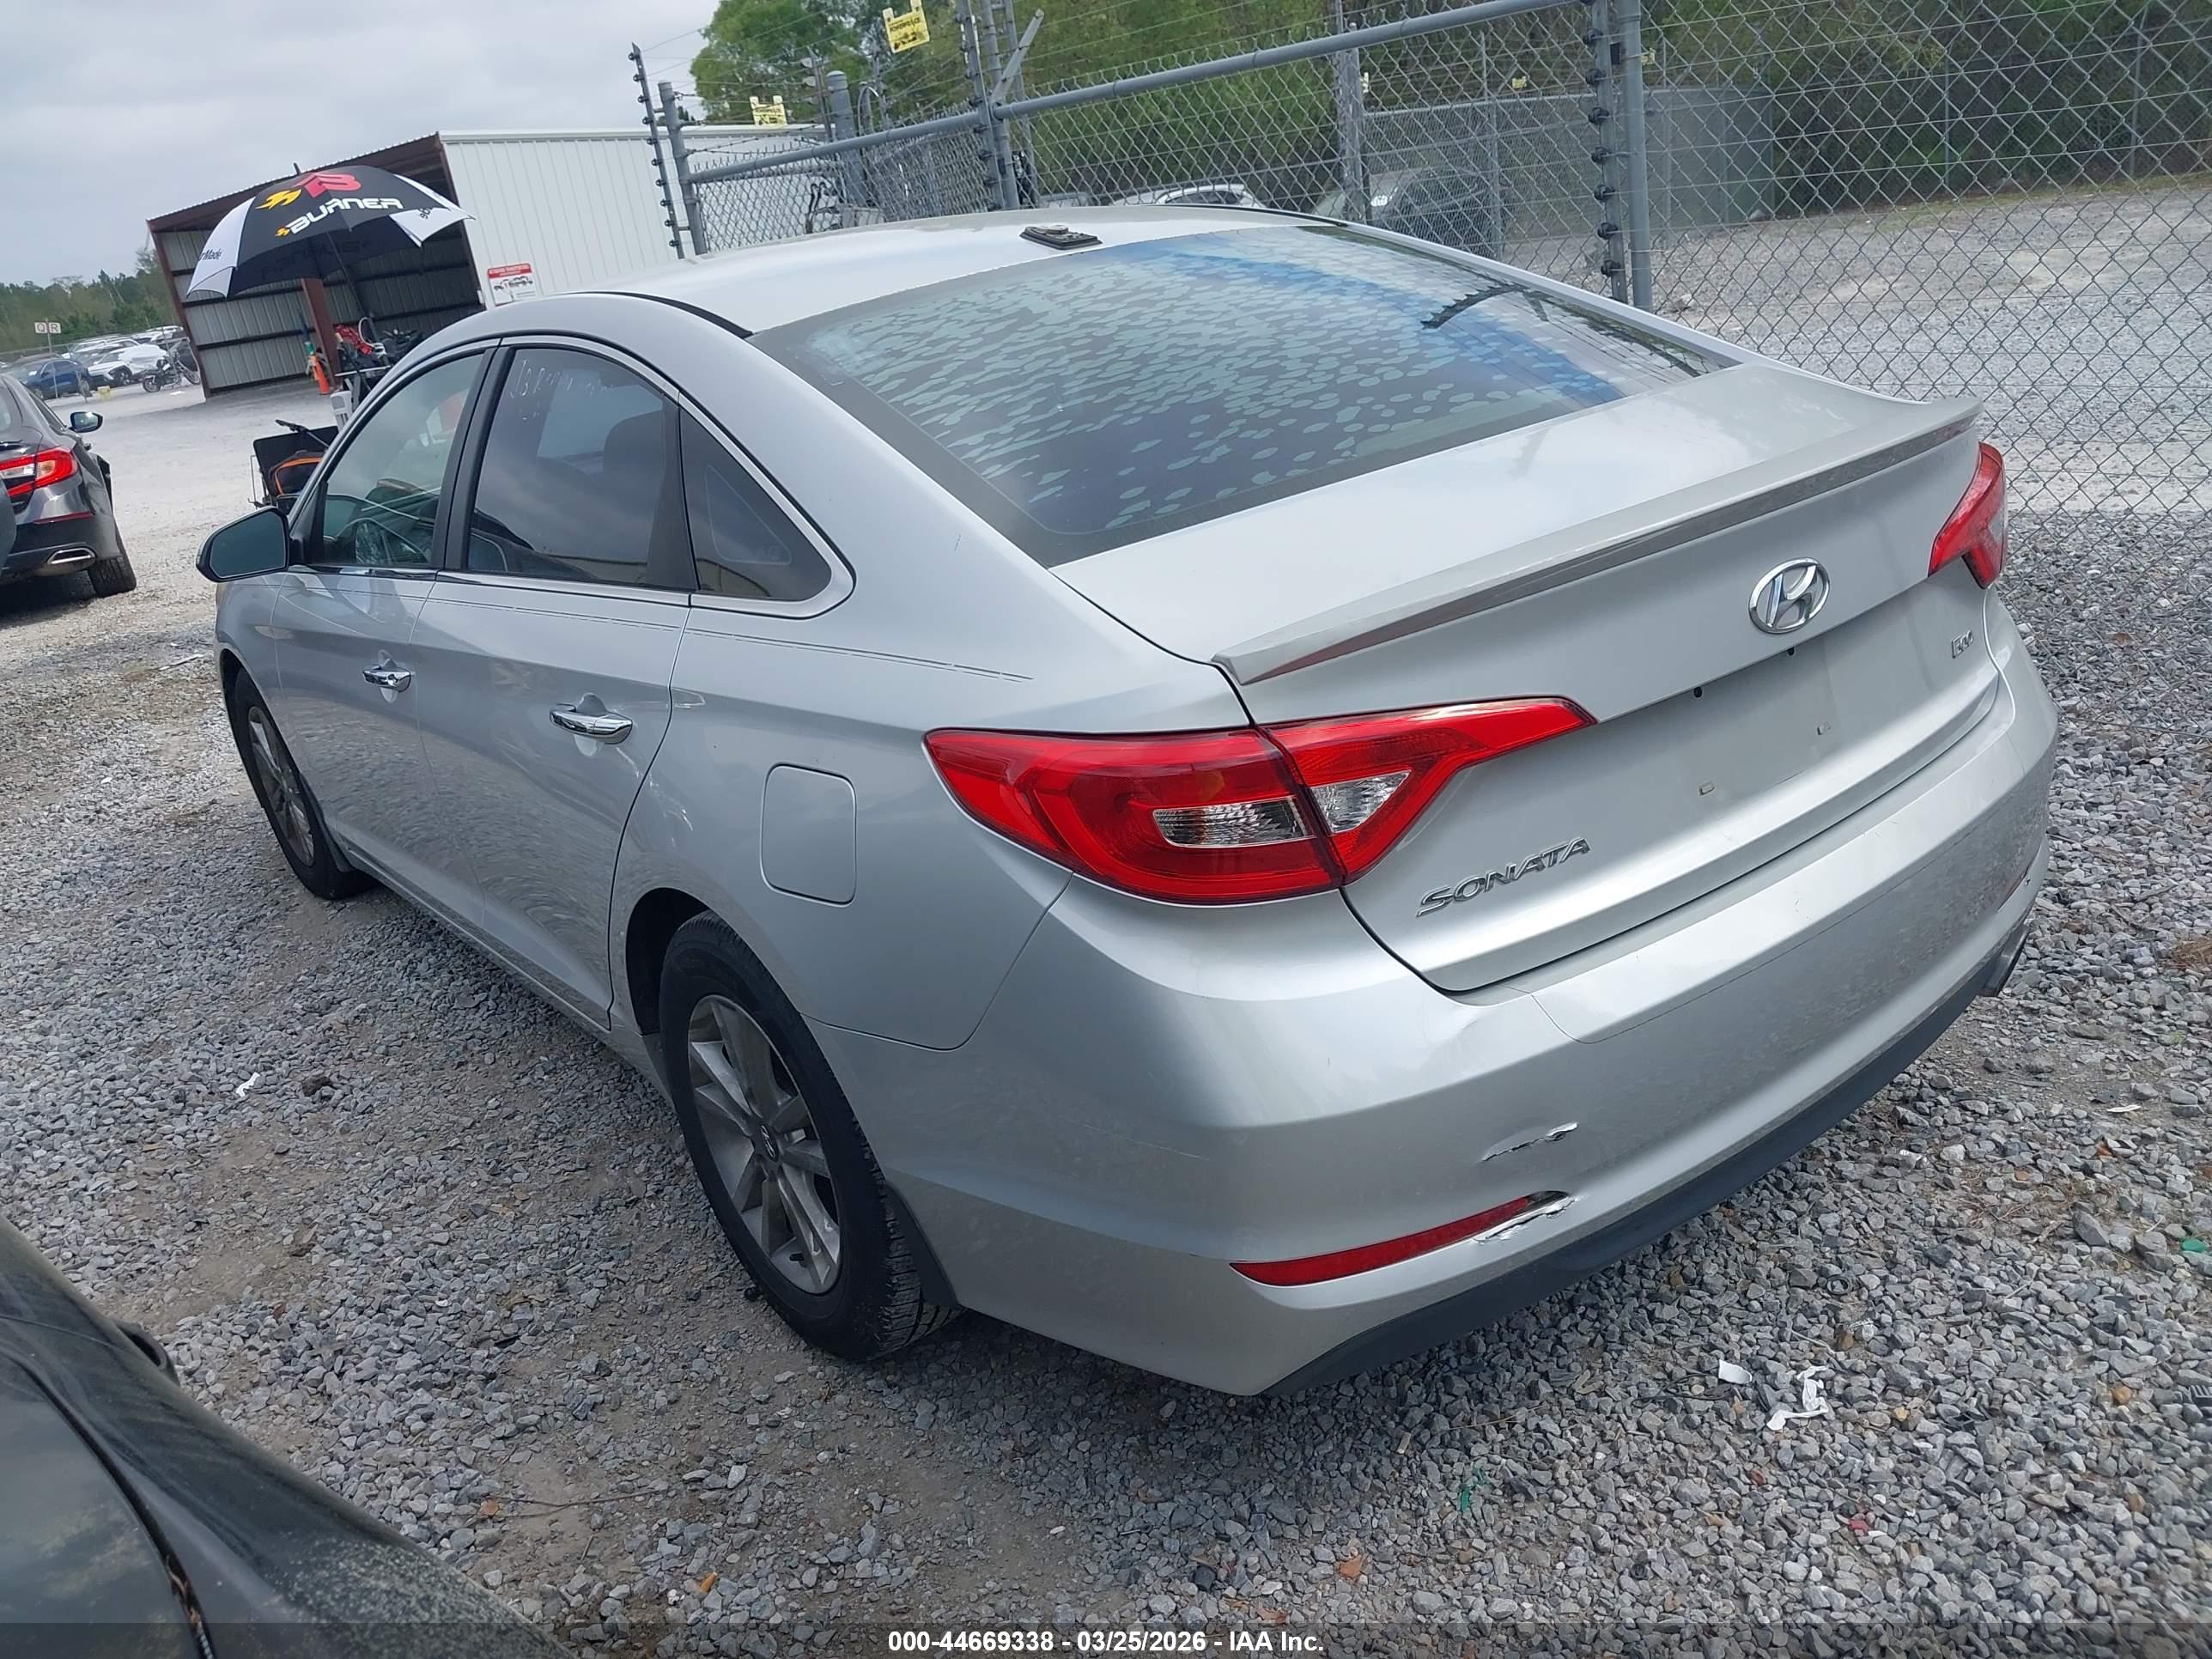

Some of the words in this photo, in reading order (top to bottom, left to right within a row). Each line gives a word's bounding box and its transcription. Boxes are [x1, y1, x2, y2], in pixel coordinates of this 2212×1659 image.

[286, 198, 404, 234] BURNER
[50, 322, 60, 333] R
[1951, 629, 1974, 659] ECO
[1415, 836, 1591, 918] SONATA
